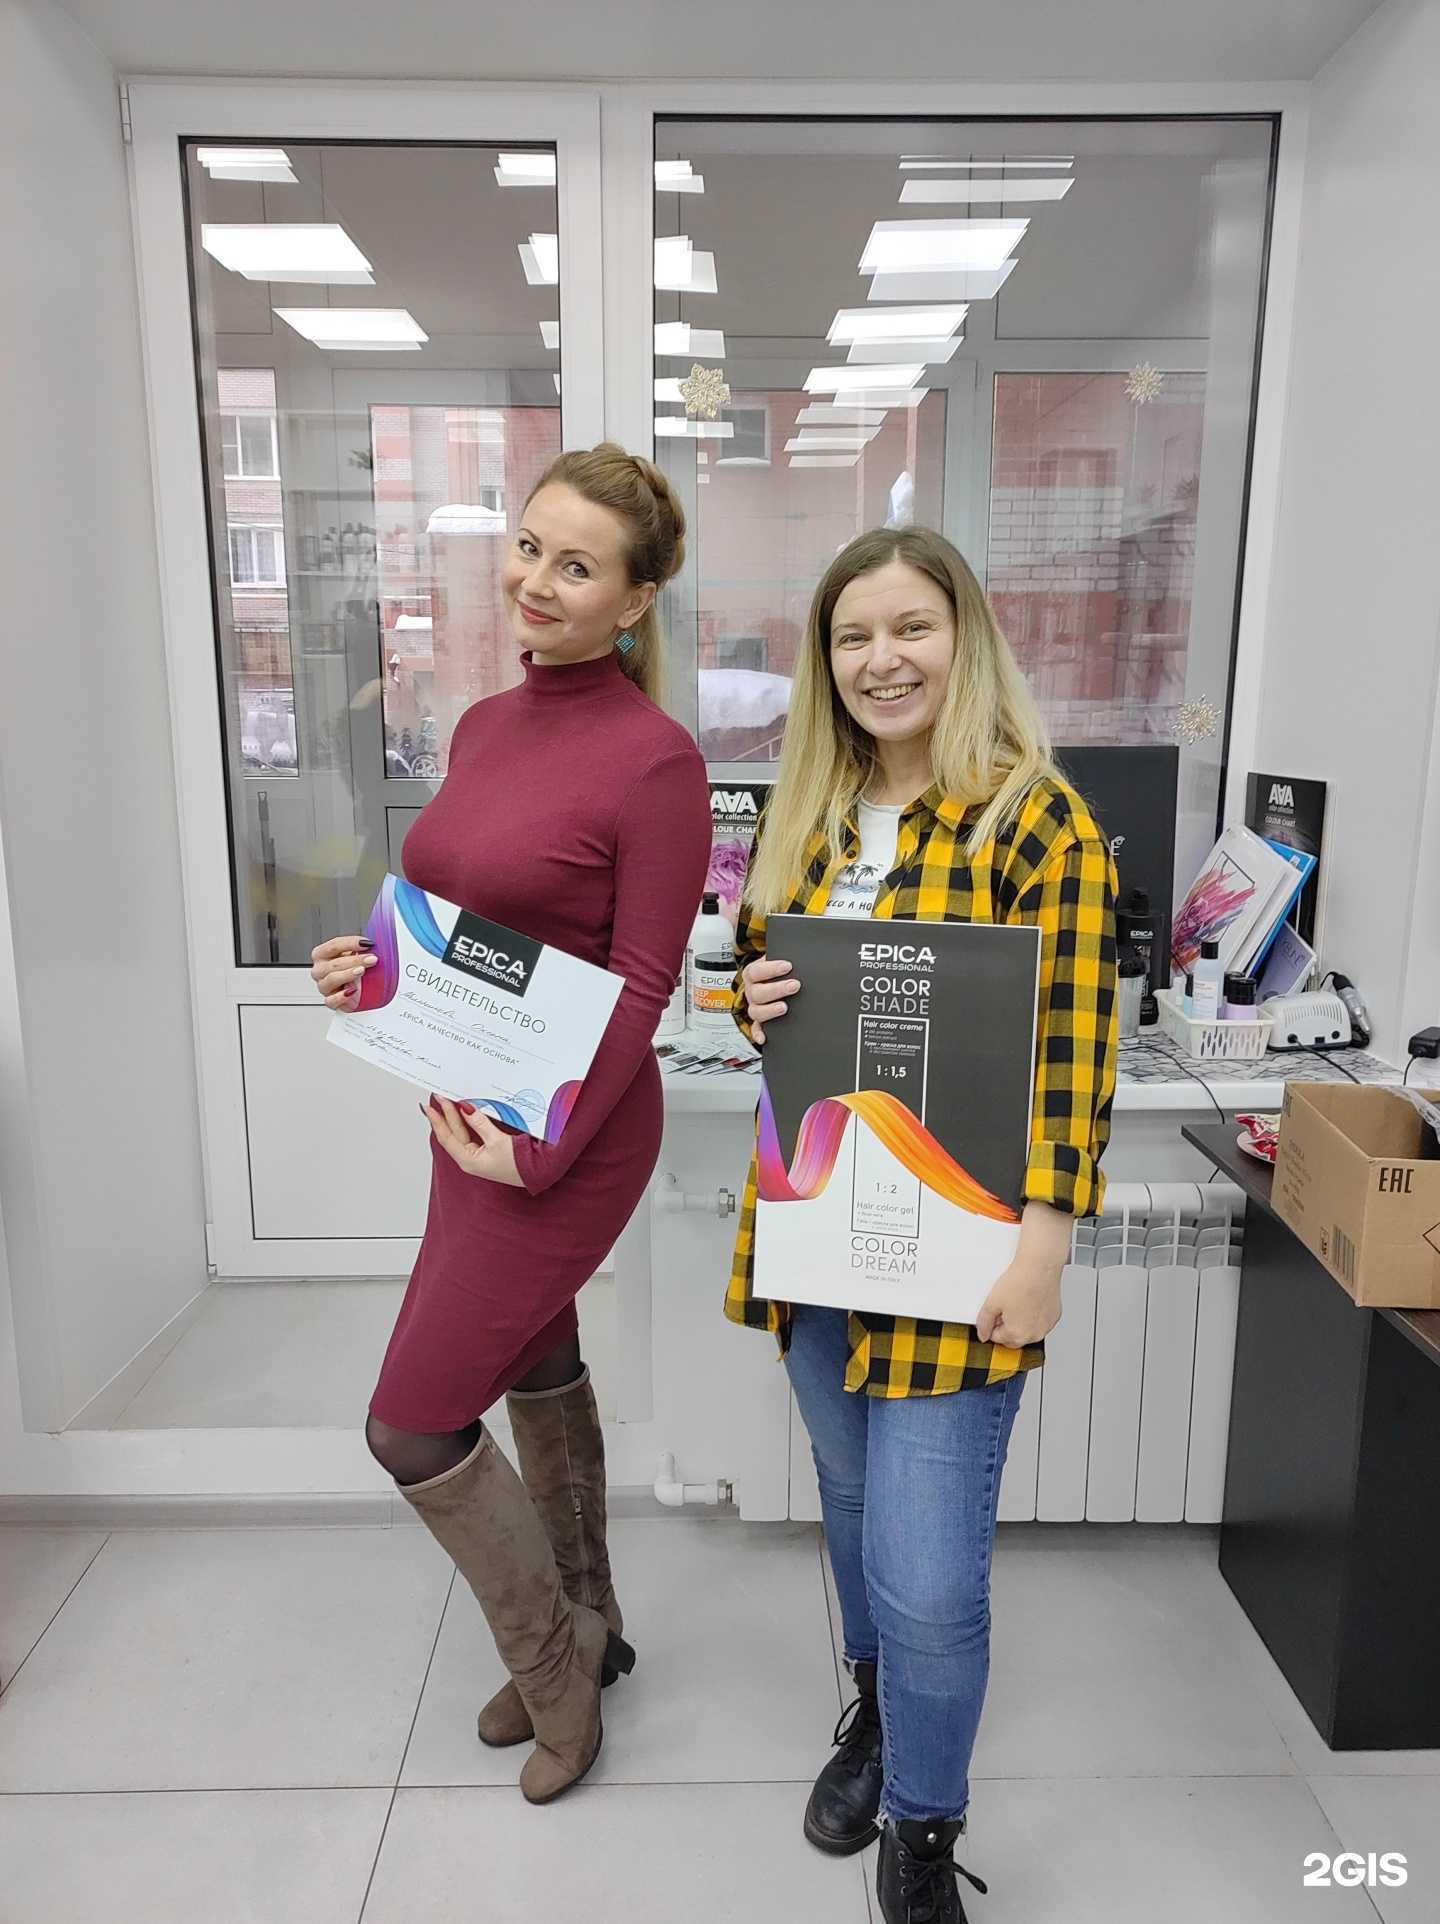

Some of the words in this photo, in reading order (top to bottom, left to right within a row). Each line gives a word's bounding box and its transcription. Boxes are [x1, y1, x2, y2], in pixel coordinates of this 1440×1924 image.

[454, 935, 528, 980] EPICA
[858, 943, 937, 965] EPICA
[451, 952, 521, 988] PROFESSIONAL
[860, 961, 935, 973] PROFESSIONAL
[860, 975, 931, 997] COLOR
[405, 963, 546, 1034] СВИДЕТЕЛЬСТВО
[860, 994, 930, 1015] SHADE
[863, 1020, 878, 1028] Hair
[879, 1021, 899, 1030] color
[467, 1040, 481, 1049] КАК
[1379, 1167, 1415, 1194] EAC
[856, 1200, 874, 1210] Hair
[876, 1202, 898, 1213] color
[900, 1207, 914, 1216] gel
[851, 1236, 918, 1257] COLOR
[851, 1253, 916, 1275] DREAM
